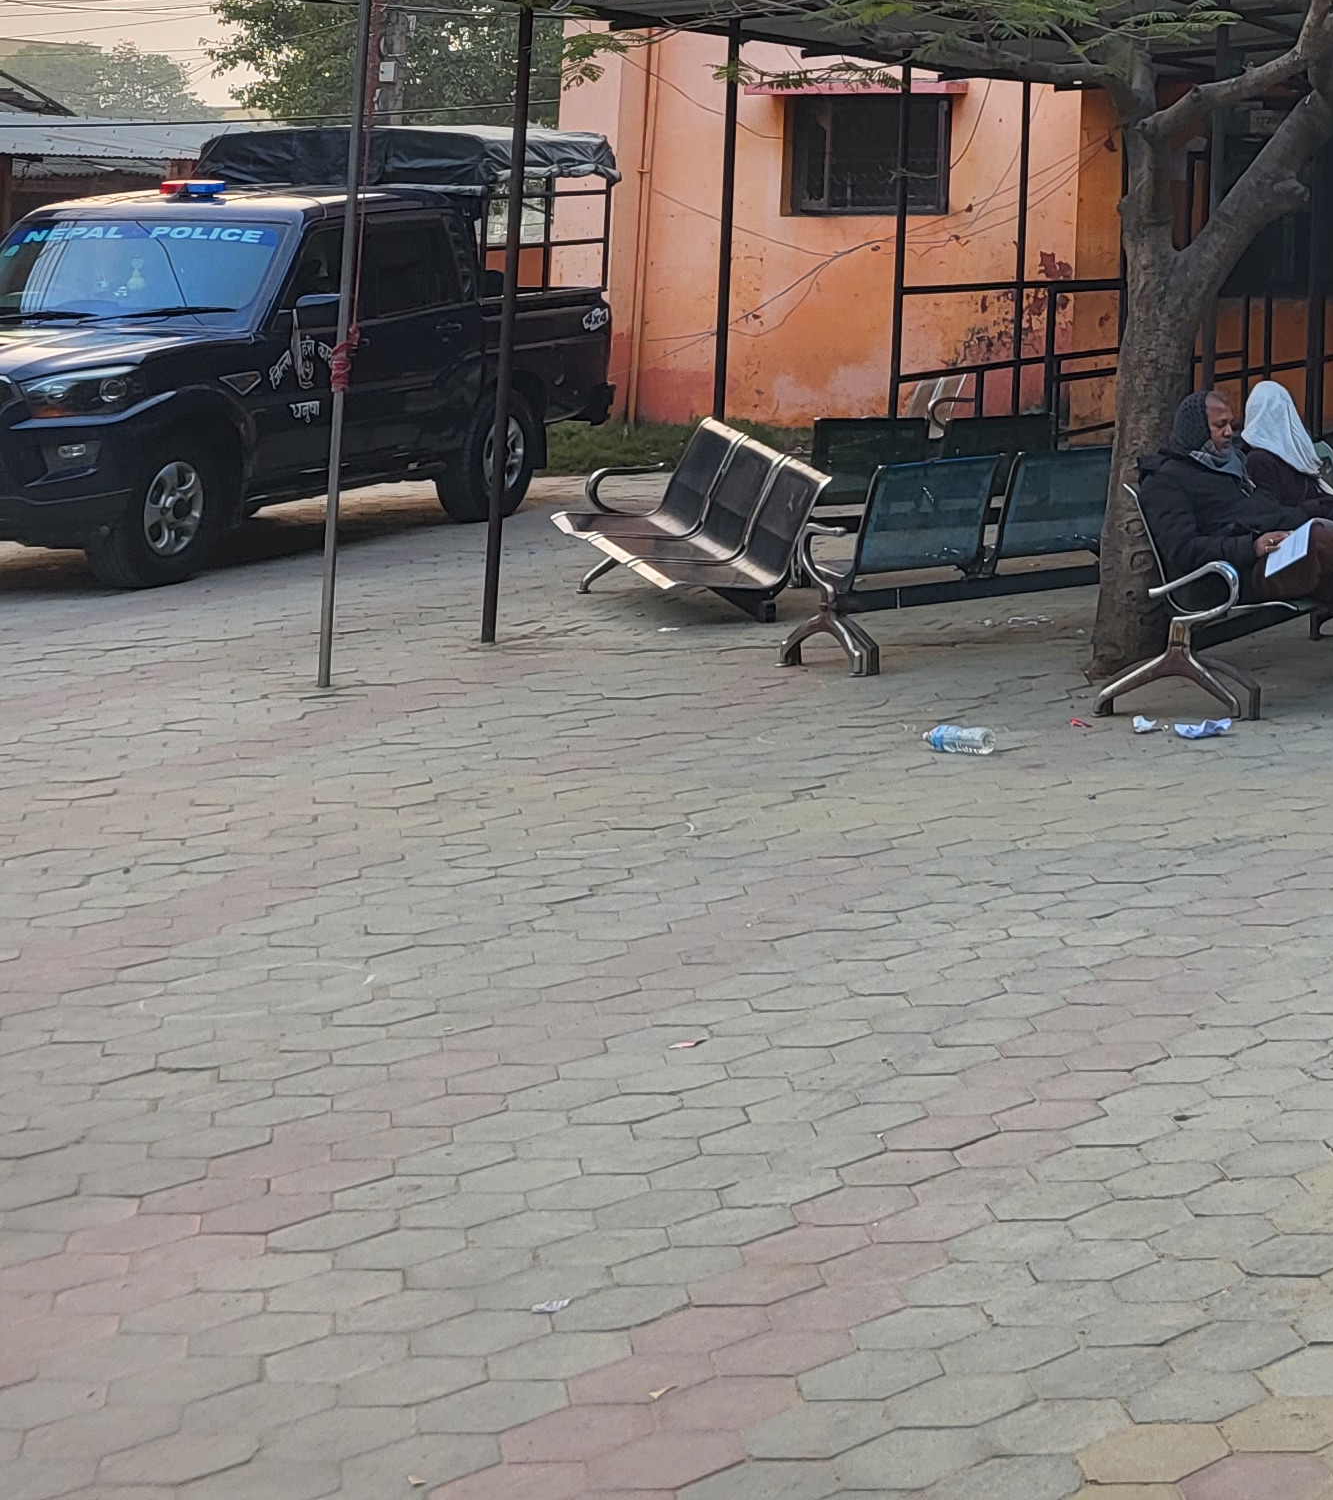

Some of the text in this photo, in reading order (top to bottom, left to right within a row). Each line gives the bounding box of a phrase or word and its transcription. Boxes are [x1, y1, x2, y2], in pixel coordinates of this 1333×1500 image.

[23, 226, 263, 244] NEPAL POLICE
[289, 400, 320, 424] धनुषा
